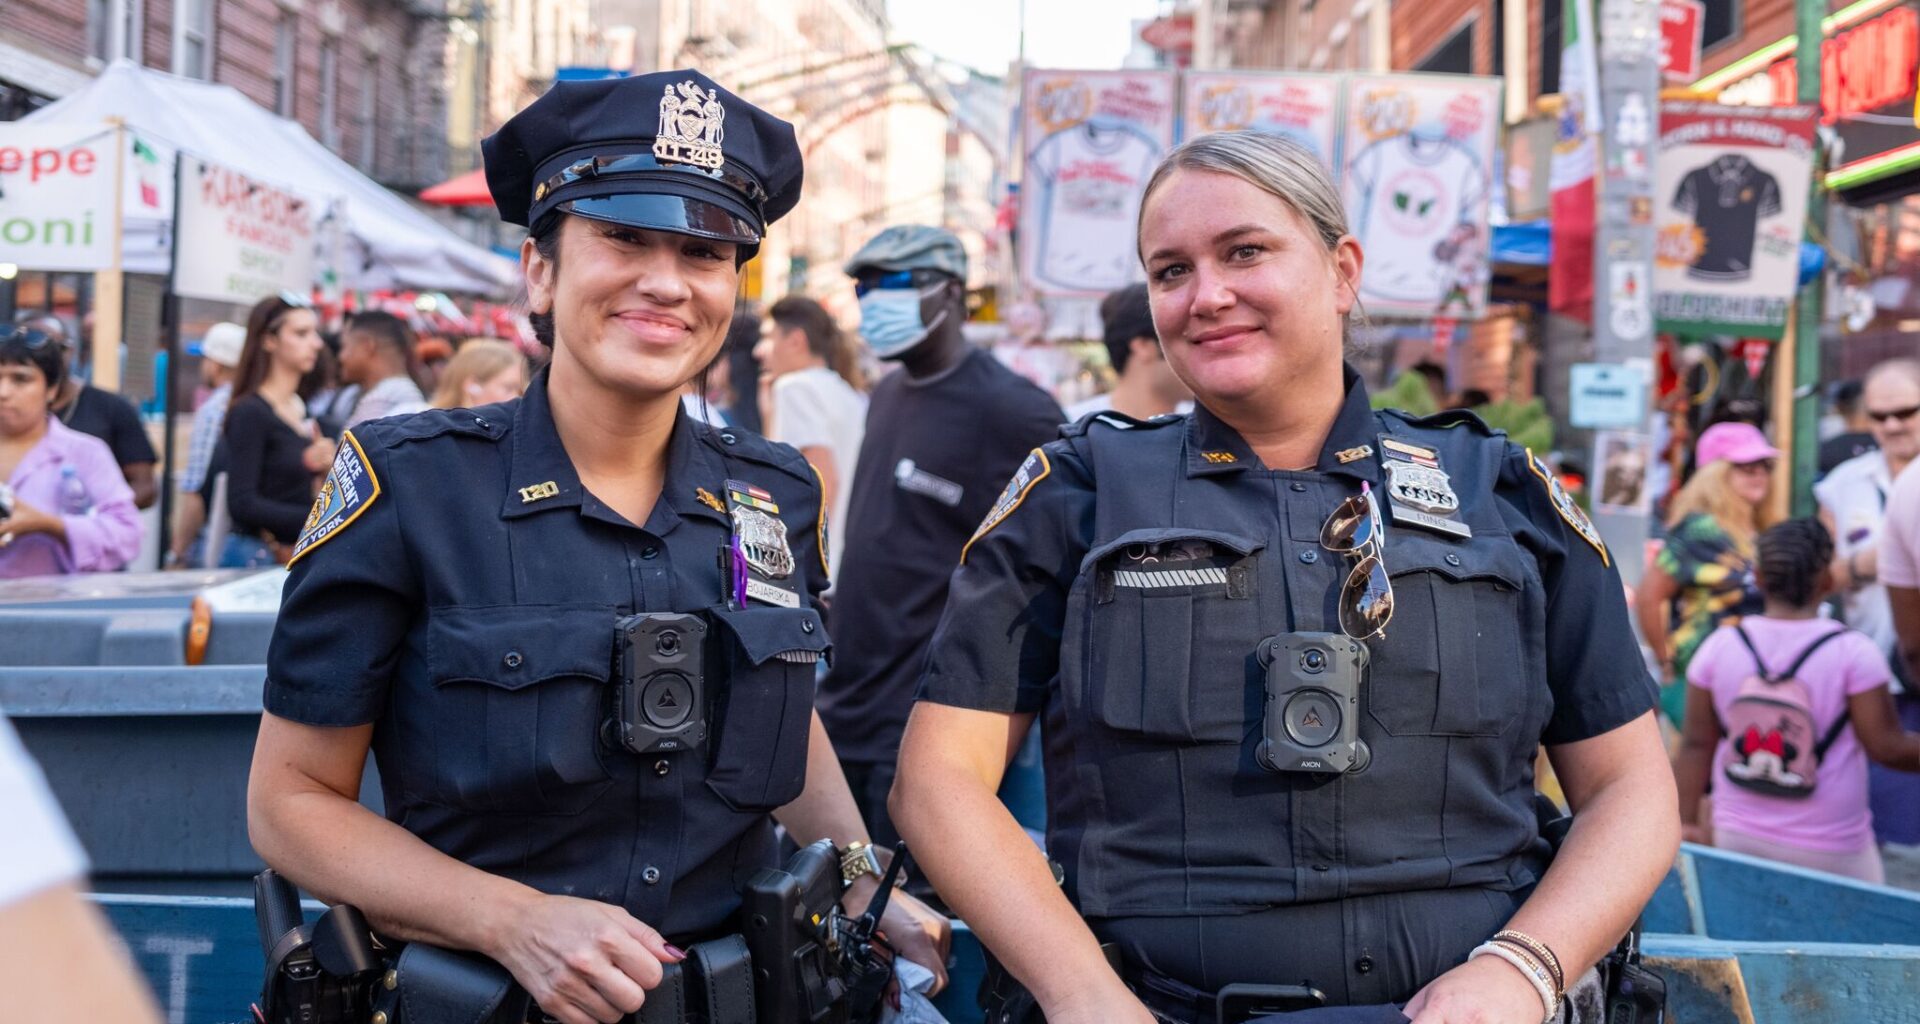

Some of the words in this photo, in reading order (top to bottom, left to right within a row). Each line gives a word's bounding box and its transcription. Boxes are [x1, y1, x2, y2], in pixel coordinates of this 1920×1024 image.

[0, 148, 96, 184] epe
[655, 142, 722, 167] 11348
[2, 210, 93, 246] oni
[340, 443, 363, 481] POLICE
[518, 481, 559, 504] 120
[310, 515, 345, 543] YORK
[747, 581, 791, 603] BOJARSKA
[659, 741, 678, 749] AXON
